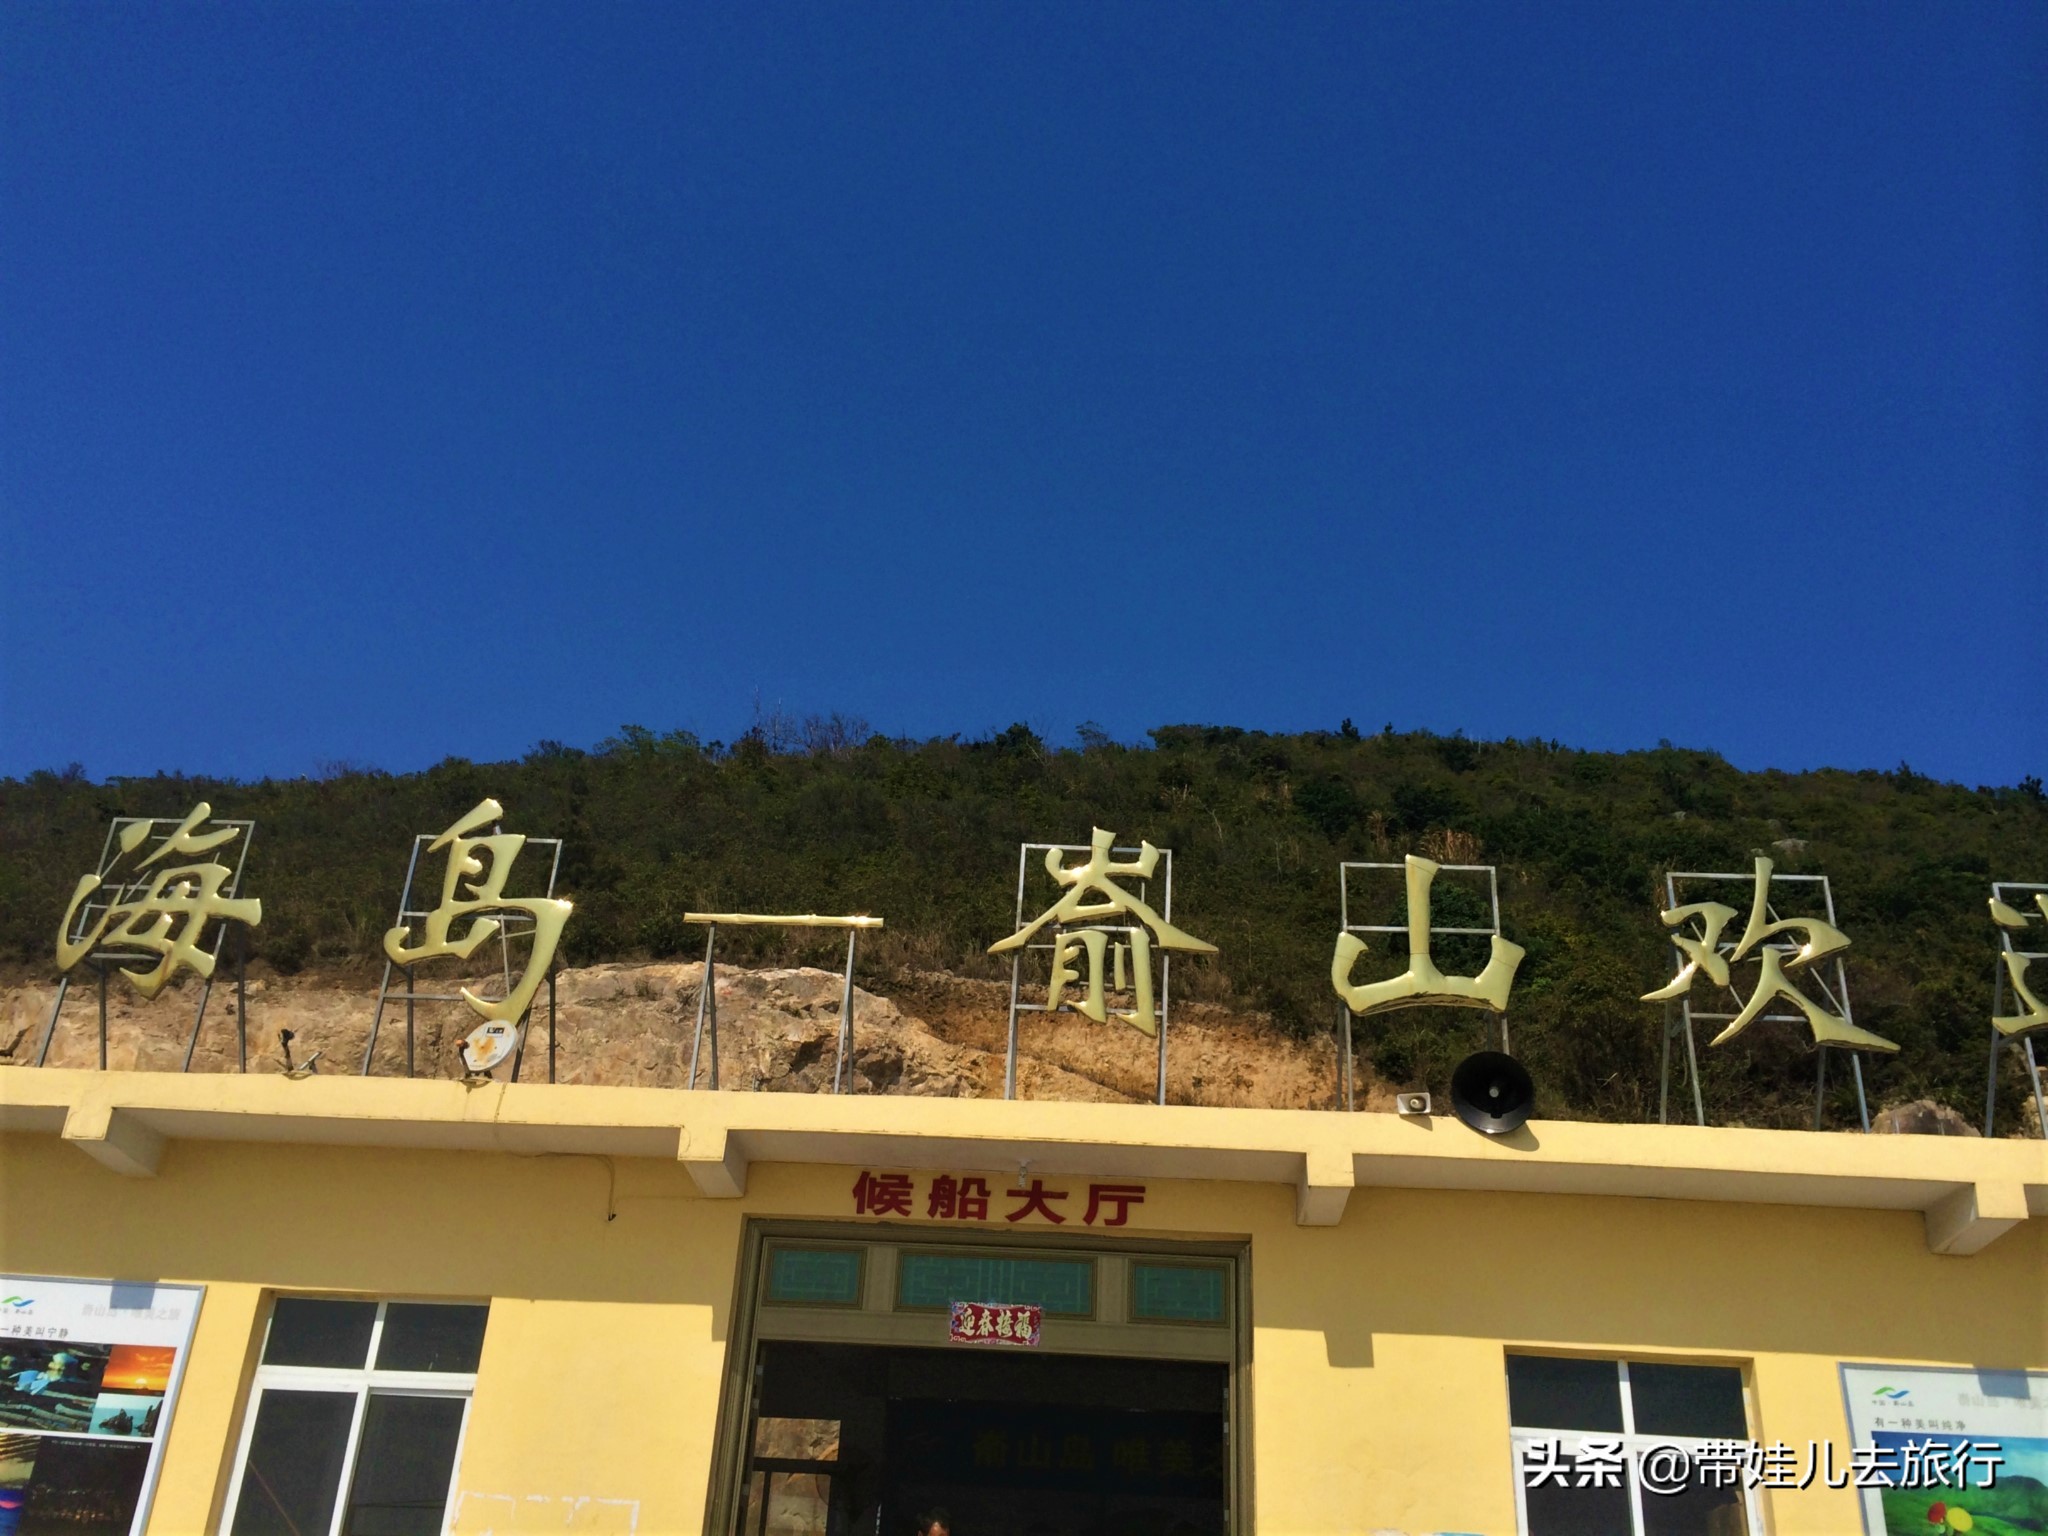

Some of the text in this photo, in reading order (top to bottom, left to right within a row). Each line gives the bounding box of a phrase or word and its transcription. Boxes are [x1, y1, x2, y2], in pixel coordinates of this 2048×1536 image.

[852, 1171, 1146, 1226] 候船大厅
[959, 1307, 1033, 1339] 迎春接福
